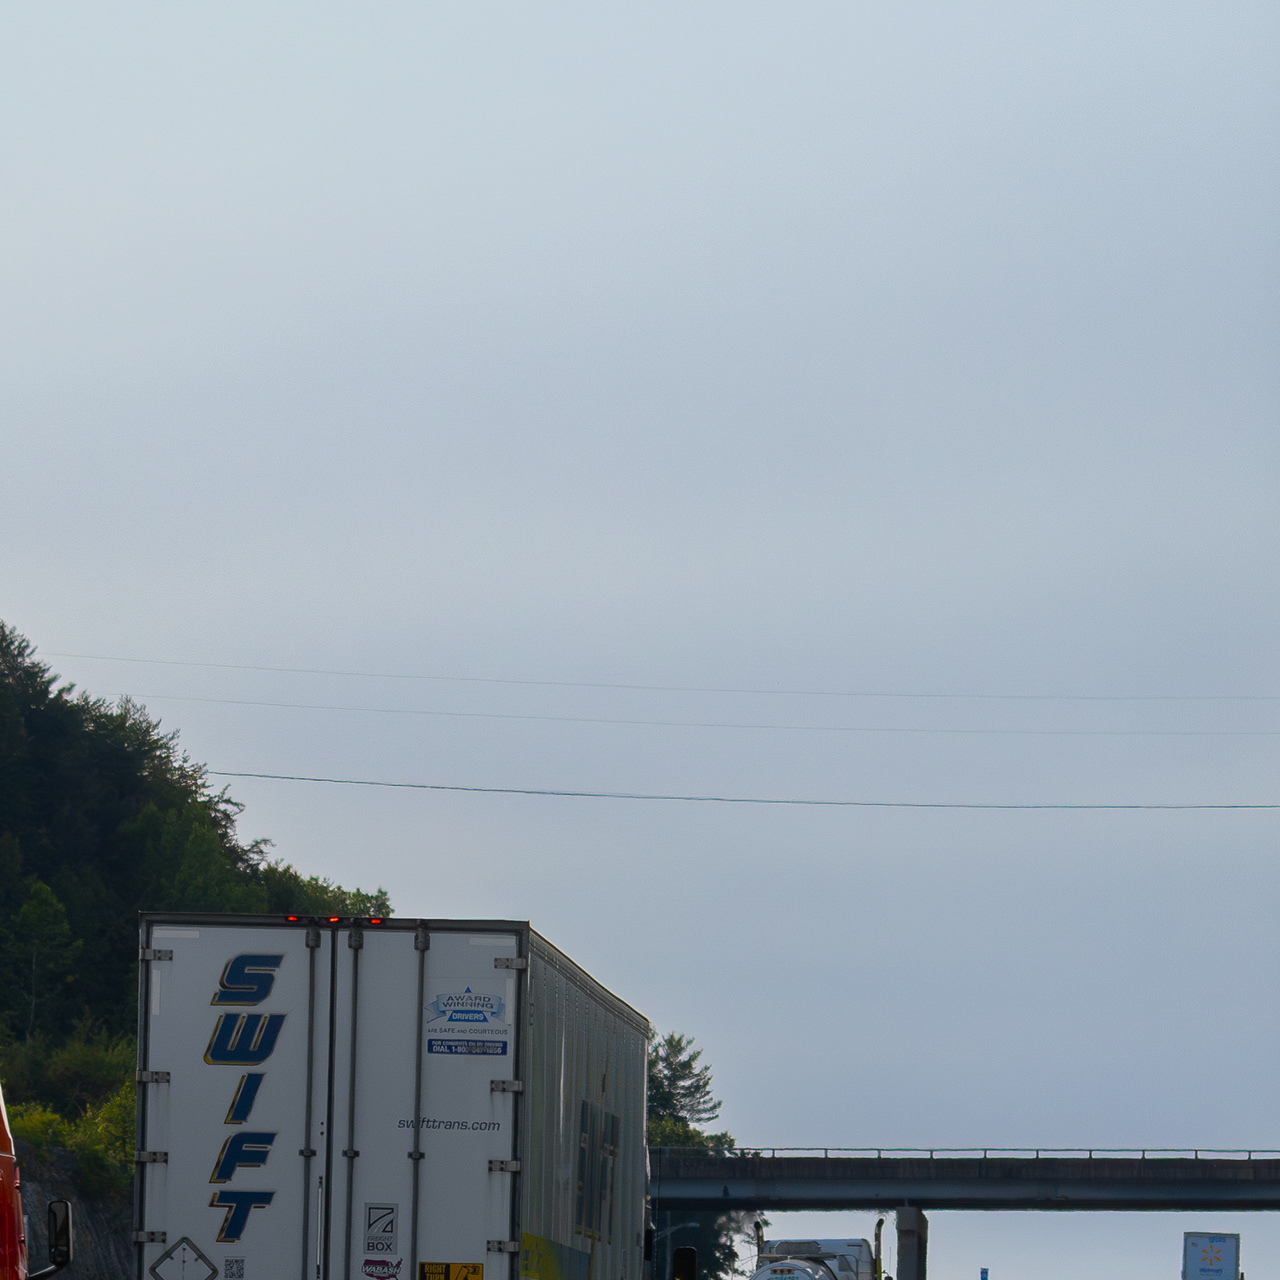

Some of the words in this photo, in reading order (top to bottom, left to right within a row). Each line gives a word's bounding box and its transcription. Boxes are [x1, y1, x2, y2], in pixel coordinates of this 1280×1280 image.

[204, 954, 287, 1243] SWIFT
[366, 1242, 393, 1252] BOX
[361, 1265, 401, 1275] WABASH
[424, 1264, 446, 1274] RIGHT
